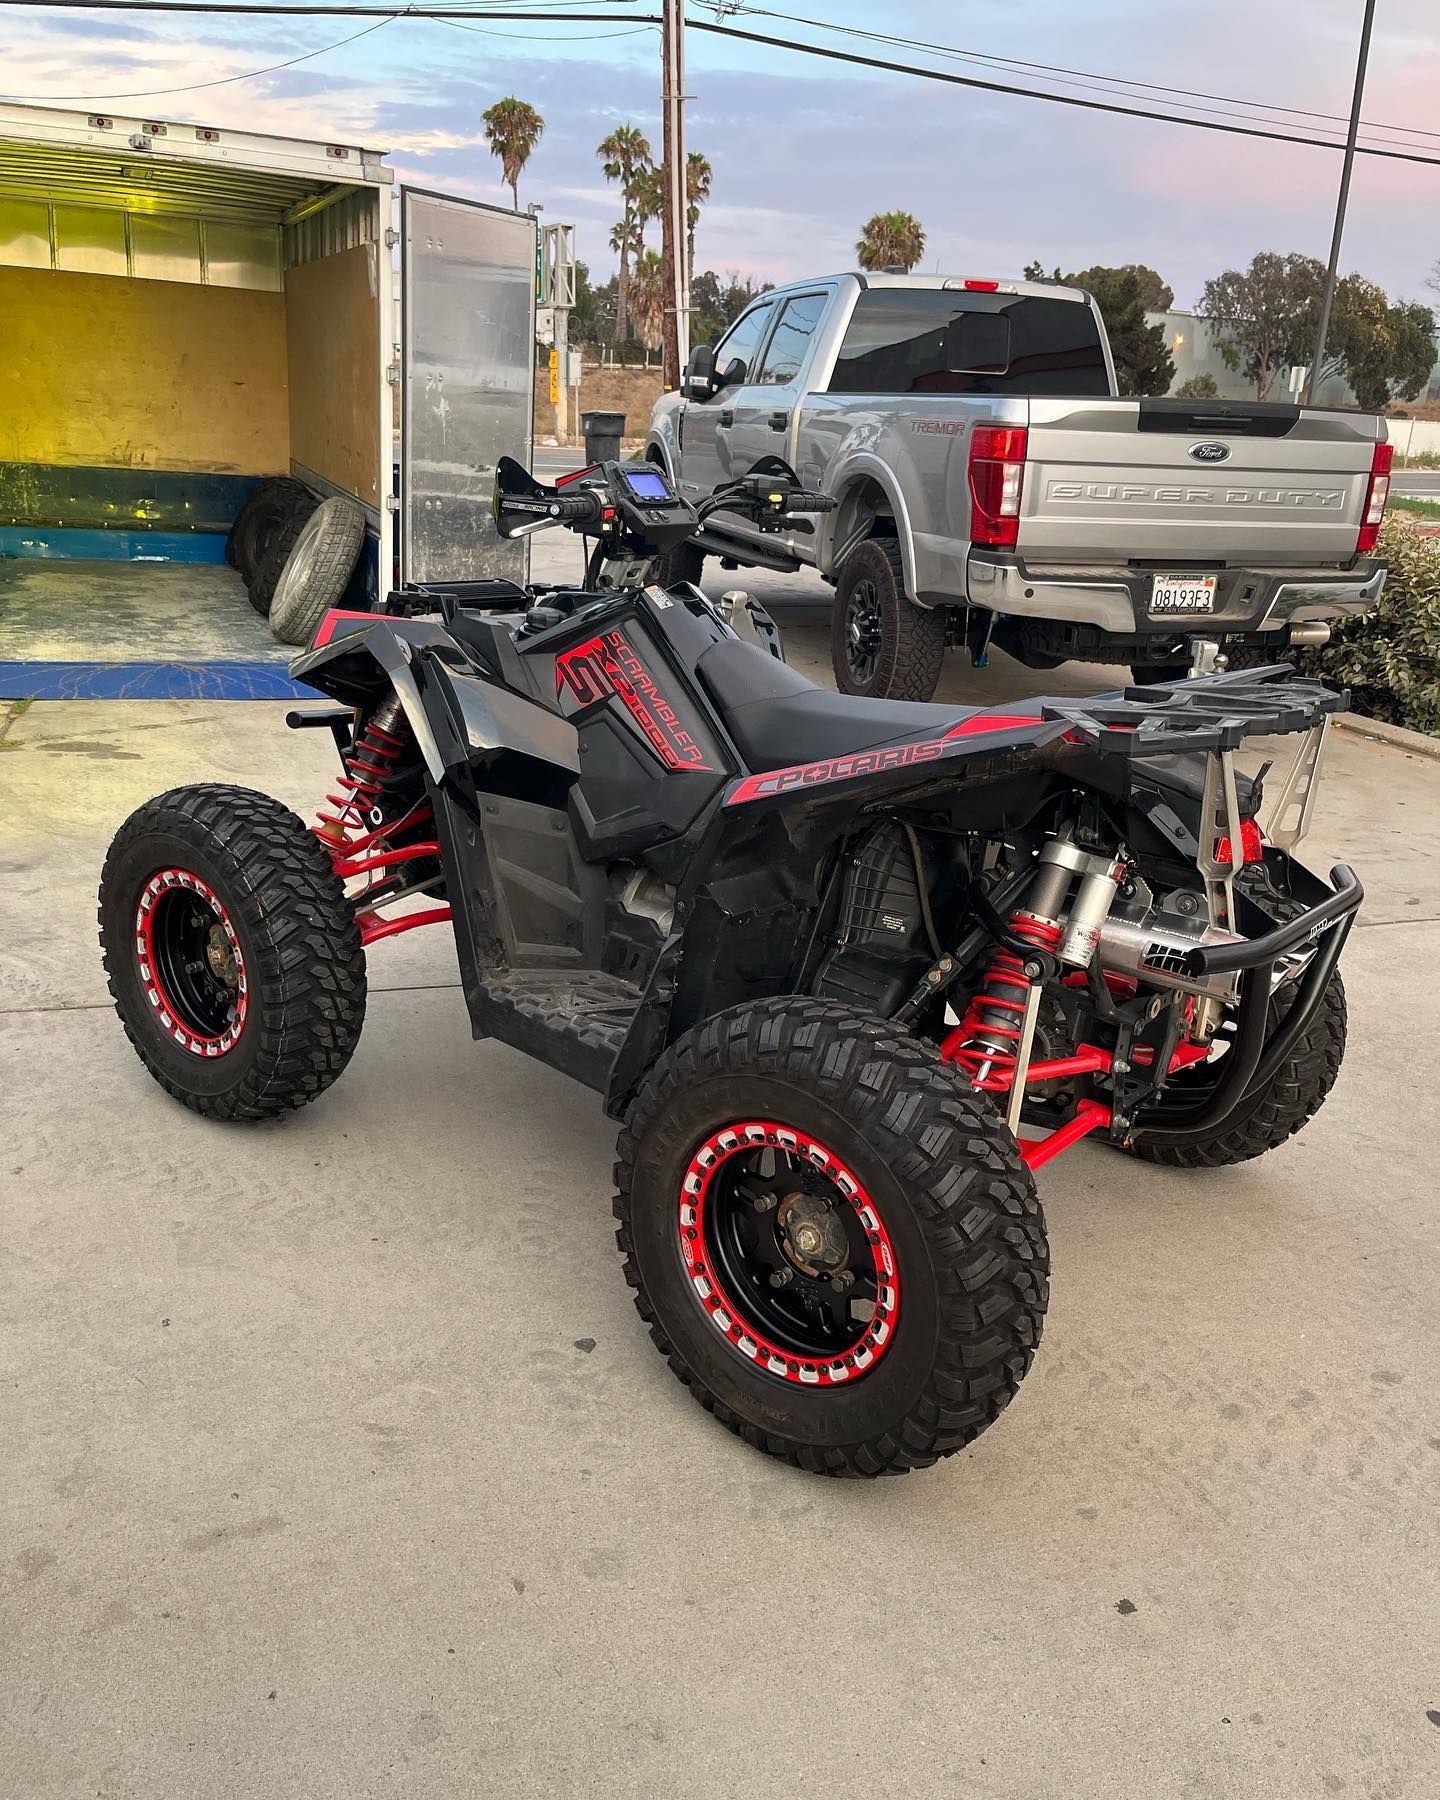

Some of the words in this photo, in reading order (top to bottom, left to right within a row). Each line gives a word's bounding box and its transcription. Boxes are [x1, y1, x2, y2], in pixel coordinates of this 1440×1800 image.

[911, 419, 966, 436] TREMOR
[1199, 445, 1223, 458] Ford
[1051, 484, 1214, 503] SUPER
[1224, 489, 1340, 506] DUTY
[1155, 590, 1211, 607] 08193F3
[606, 630, 704, 762] SCRAMBLER
[775, 738, 945, 790] POLARIS
